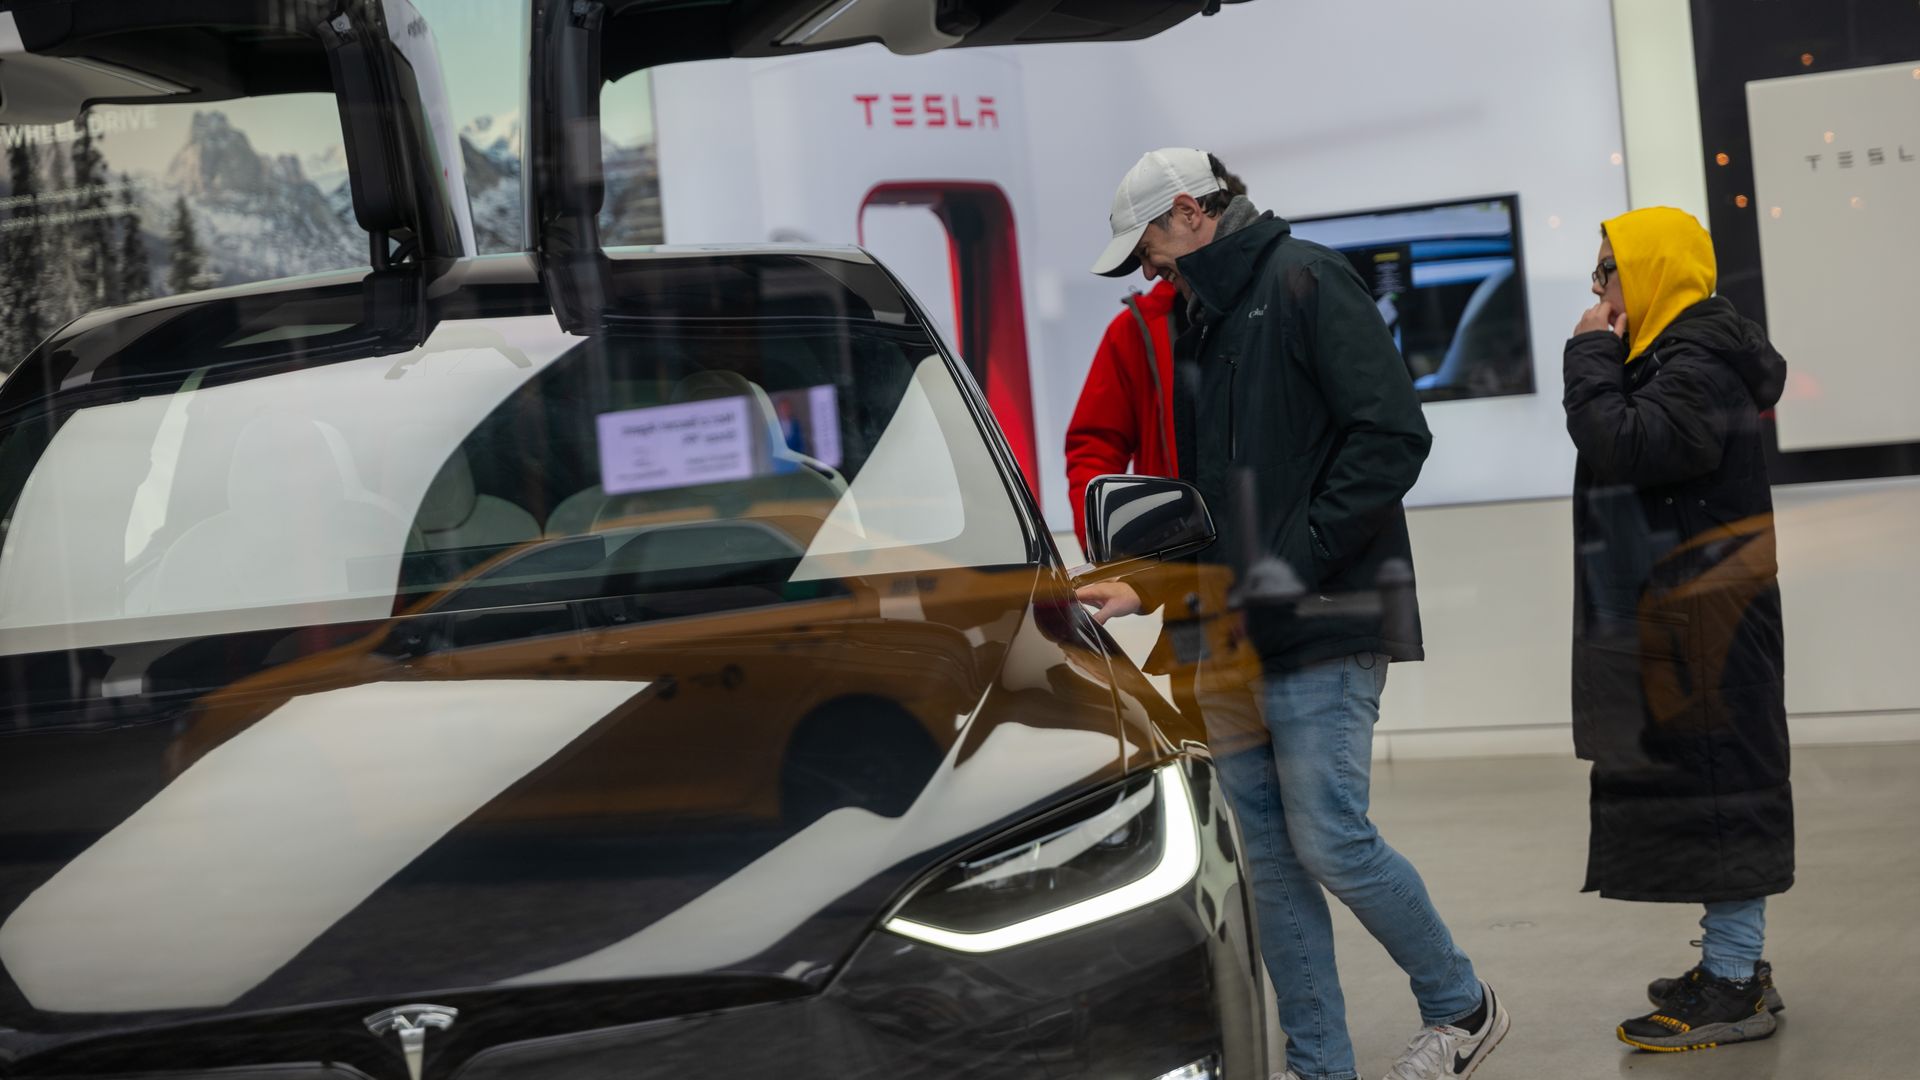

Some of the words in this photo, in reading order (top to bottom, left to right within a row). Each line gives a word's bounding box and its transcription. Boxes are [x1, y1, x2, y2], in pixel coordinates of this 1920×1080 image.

[87, 108, 156, 138] DRIVE
[853, 94, 999, 128] TESLA
[1804, 145, 1916, 172] TESL
